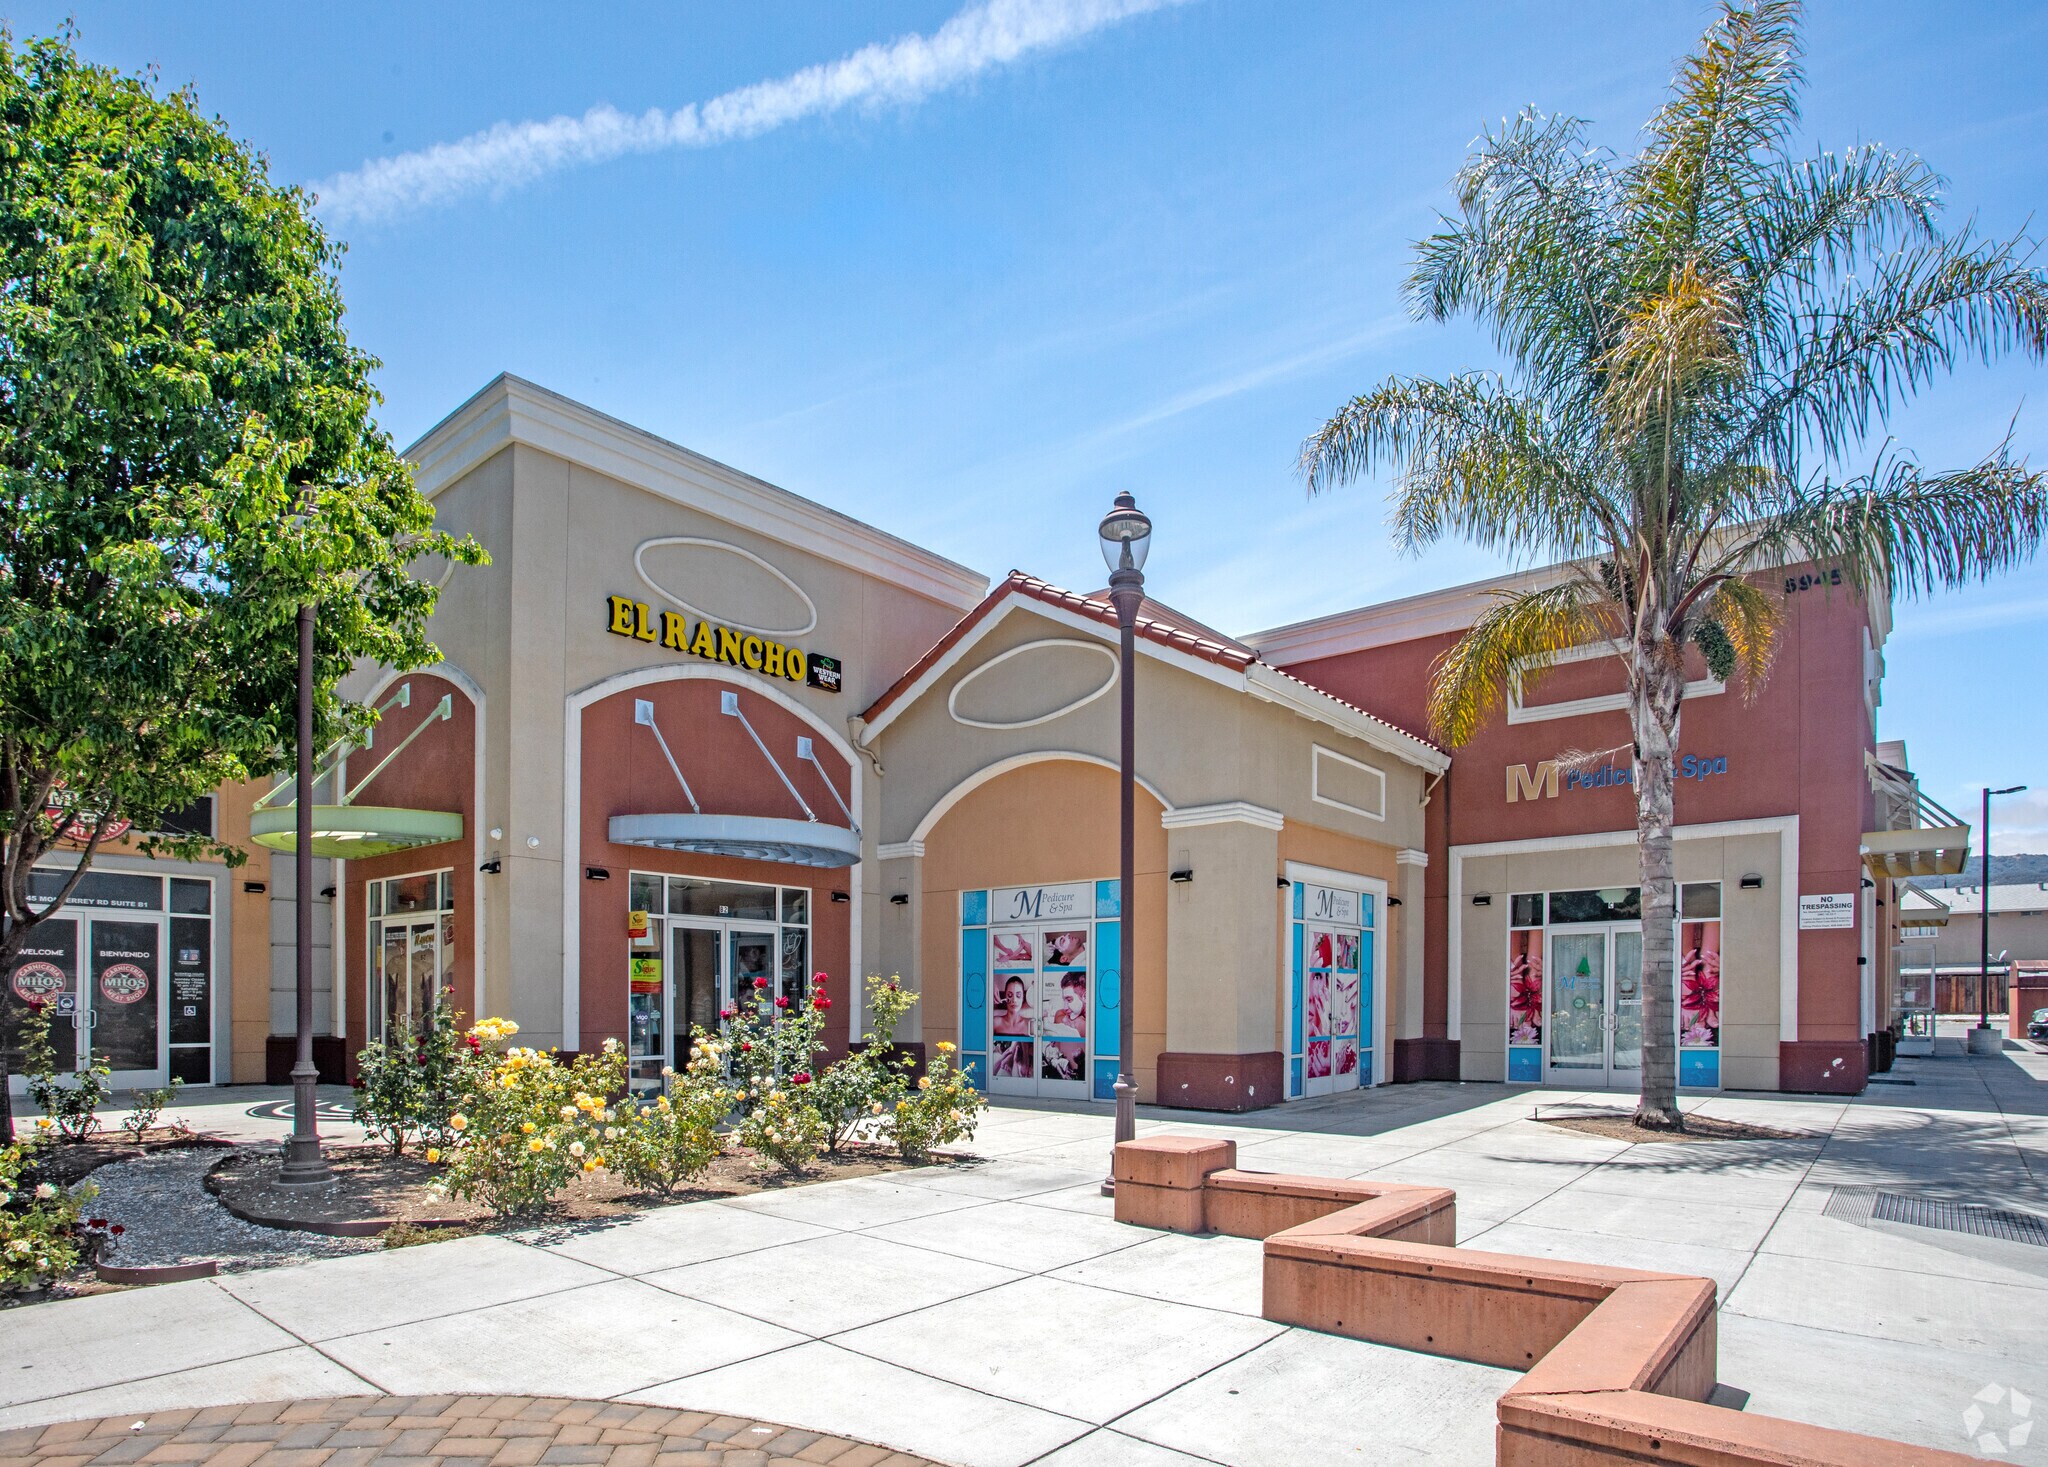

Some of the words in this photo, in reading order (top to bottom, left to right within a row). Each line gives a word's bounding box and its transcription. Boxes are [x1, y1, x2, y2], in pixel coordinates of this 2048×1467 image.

[607, 595, 657, 643] EL
[660, 611, 806, 682] RANCHO
[813, 665, 841, 679] WESTERN
[818, 673, 836, 685] WEAR
[1506, 760, 1559, 803] M
[1567, 764, 1634, 791] Pedicu
[1681, 754, 1728, 782] Spa
[110, 900, 136, 908] SUITE
[1010, 889, 1042, 919] M
[1042, 893, 1074, 902] Pedicure
[1050, 903, 1057, 914] &
[1058, 902, 1072, 914] Spa
[1315, 890, 1333, 918] M
[1332, 896, 1350, 907] Pedicure
[19, 963, 61, 977] CARNICERIA
[105, 965, 144, 978] CARNICERIA
[634, 960, 656, 974] Sigue
[17, 976, 64, 989] MILOS
[104, 977, 147, 989] MILOS
[20, 987, 39, 1001] MEAT
[106, 988, 124, 1001] MEAT
[126, 989, 143, 1002] SHOP
